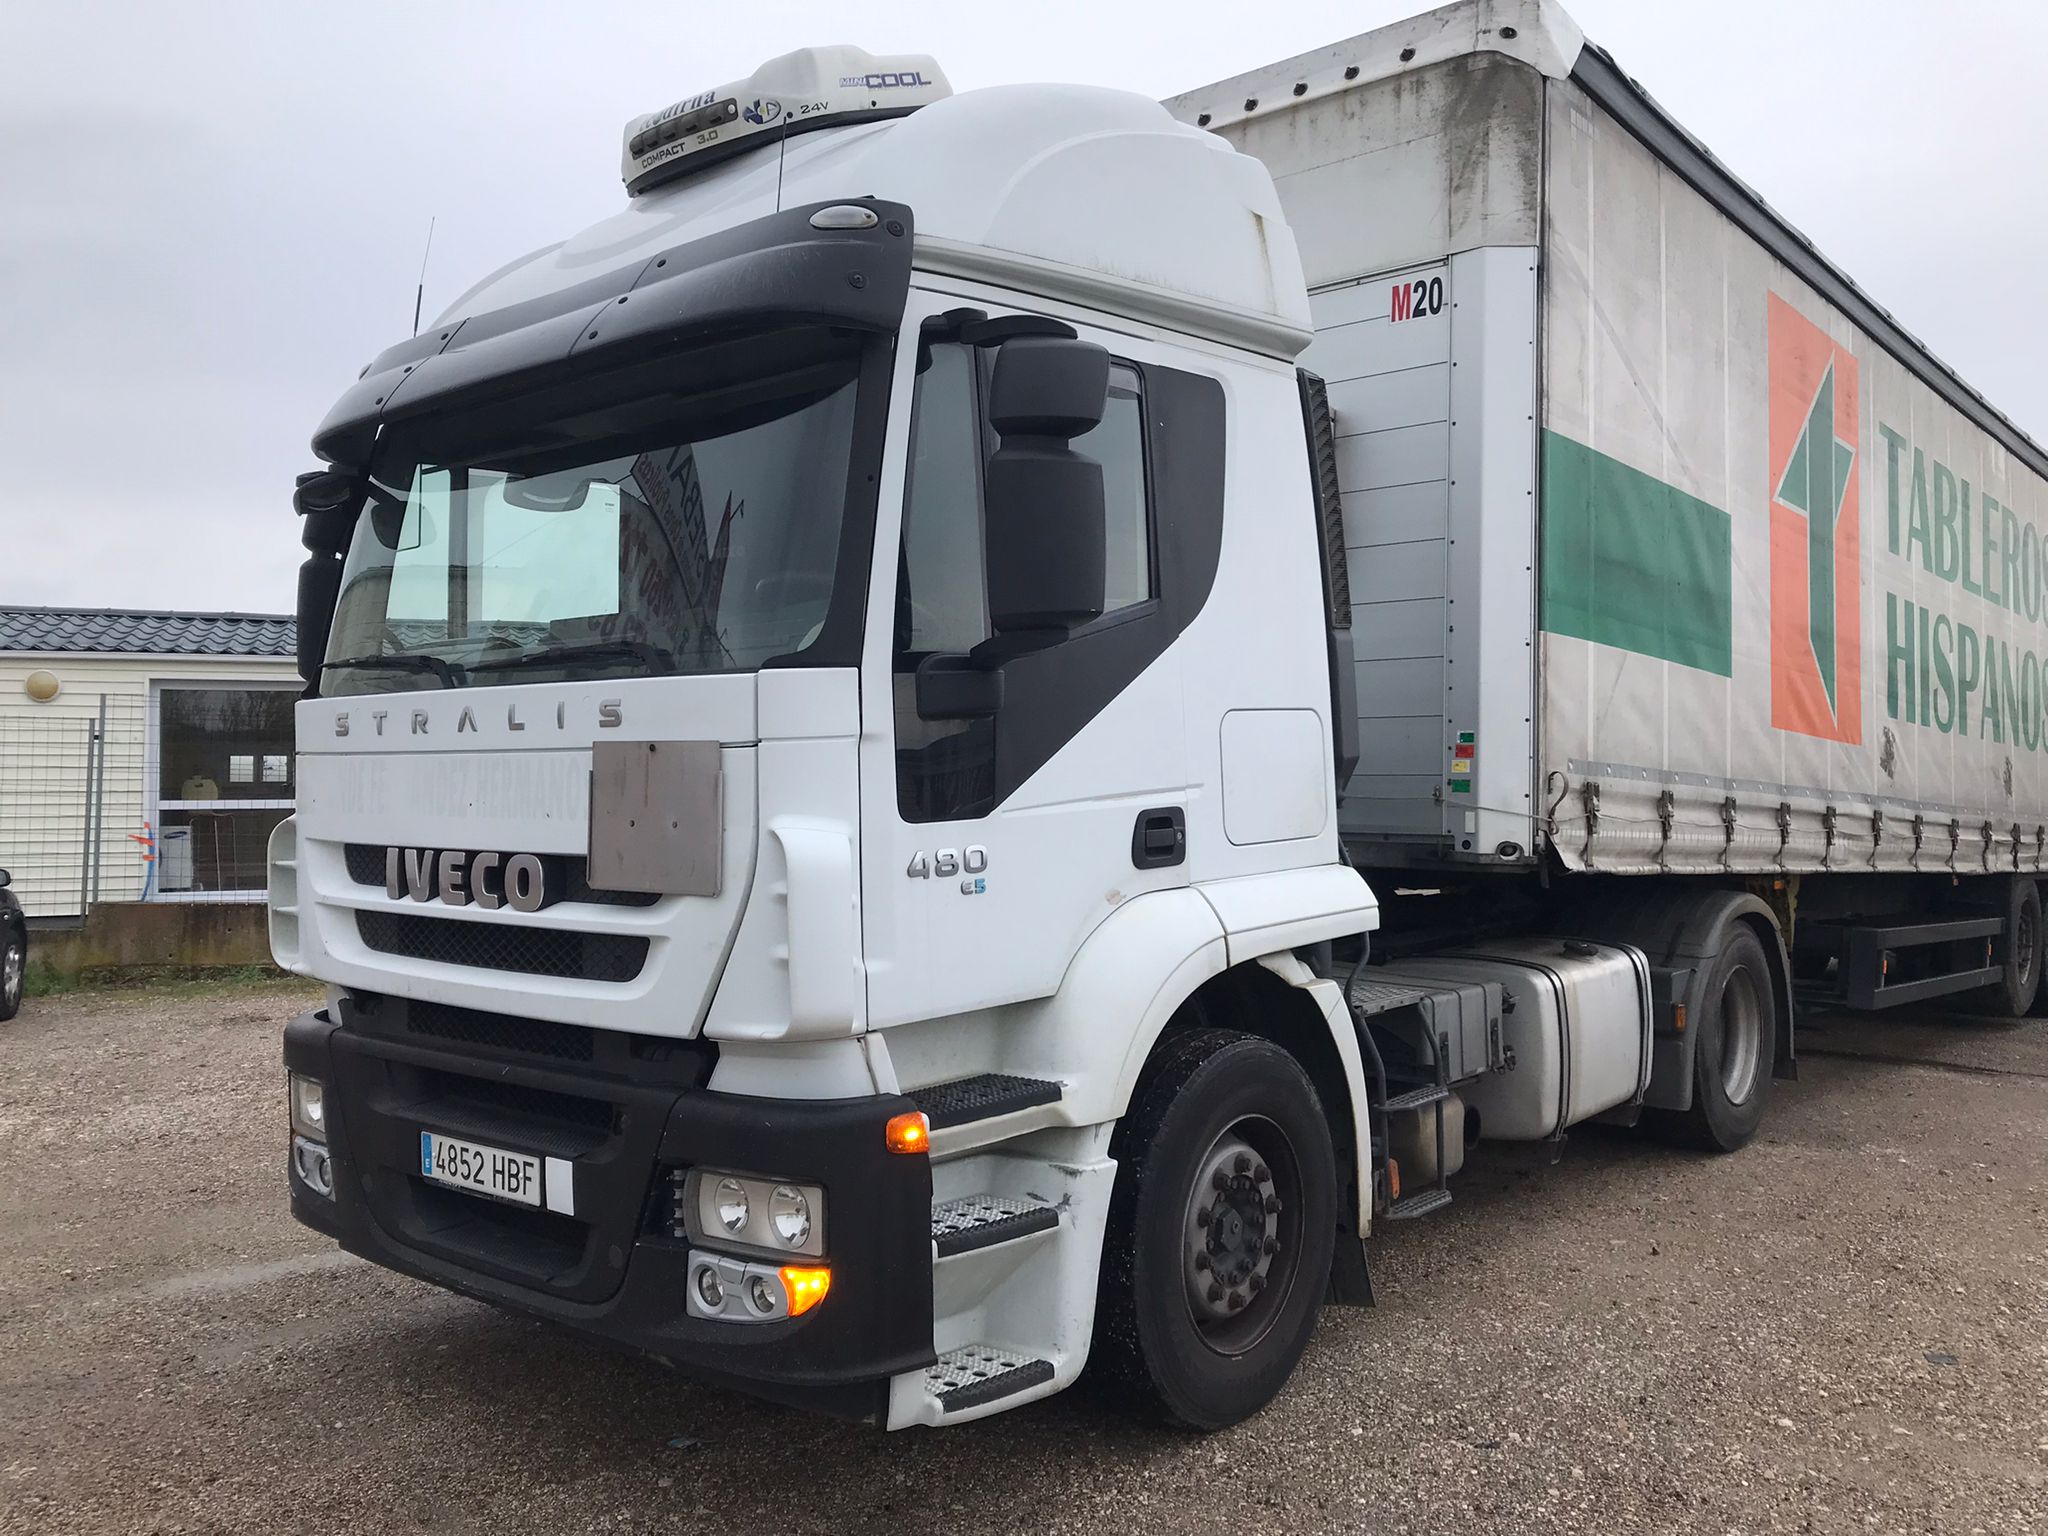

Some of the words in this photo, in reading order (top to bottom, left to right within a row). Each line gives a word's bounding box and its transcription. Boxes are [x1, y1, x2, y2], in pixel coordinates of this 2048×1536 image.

[800, 101, 829, 114] 24V
[641, 142, 686, 169] COMPACT
[696, 130, 719, 144] 3.0
[1391, 277, 1443, 322] M20
[335, 698, 623, 738] STRALIS
[385, 847, 546, 913] IVECO
[906, 844, 989, 880] 480
[960, 878, 987, 896] E5
[436, 1141, 485, 1185] 4852
[492, 1154, 534, 1196] HBF
